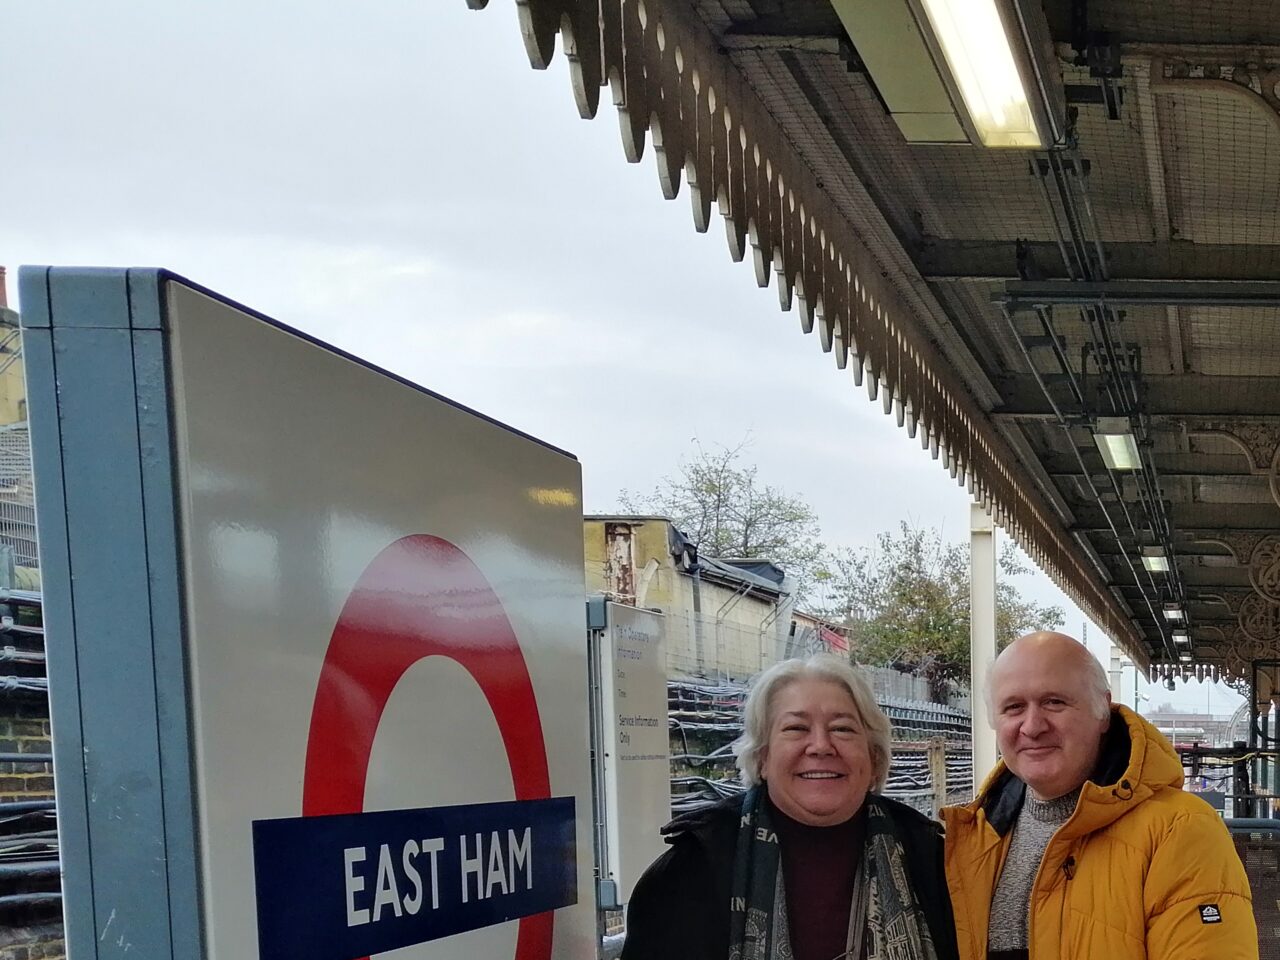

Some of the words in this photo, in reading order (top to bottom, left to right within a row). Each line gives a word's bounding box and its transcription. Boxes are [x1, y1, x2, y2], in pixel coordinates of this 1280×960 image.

[619, 714, 634, 727] Service
[635, 714, 659, 727] Information
[620, 731, 630, 746] Only
[343, 837, 445, 927] EAST
[459, 826, 533, 903] HAM
